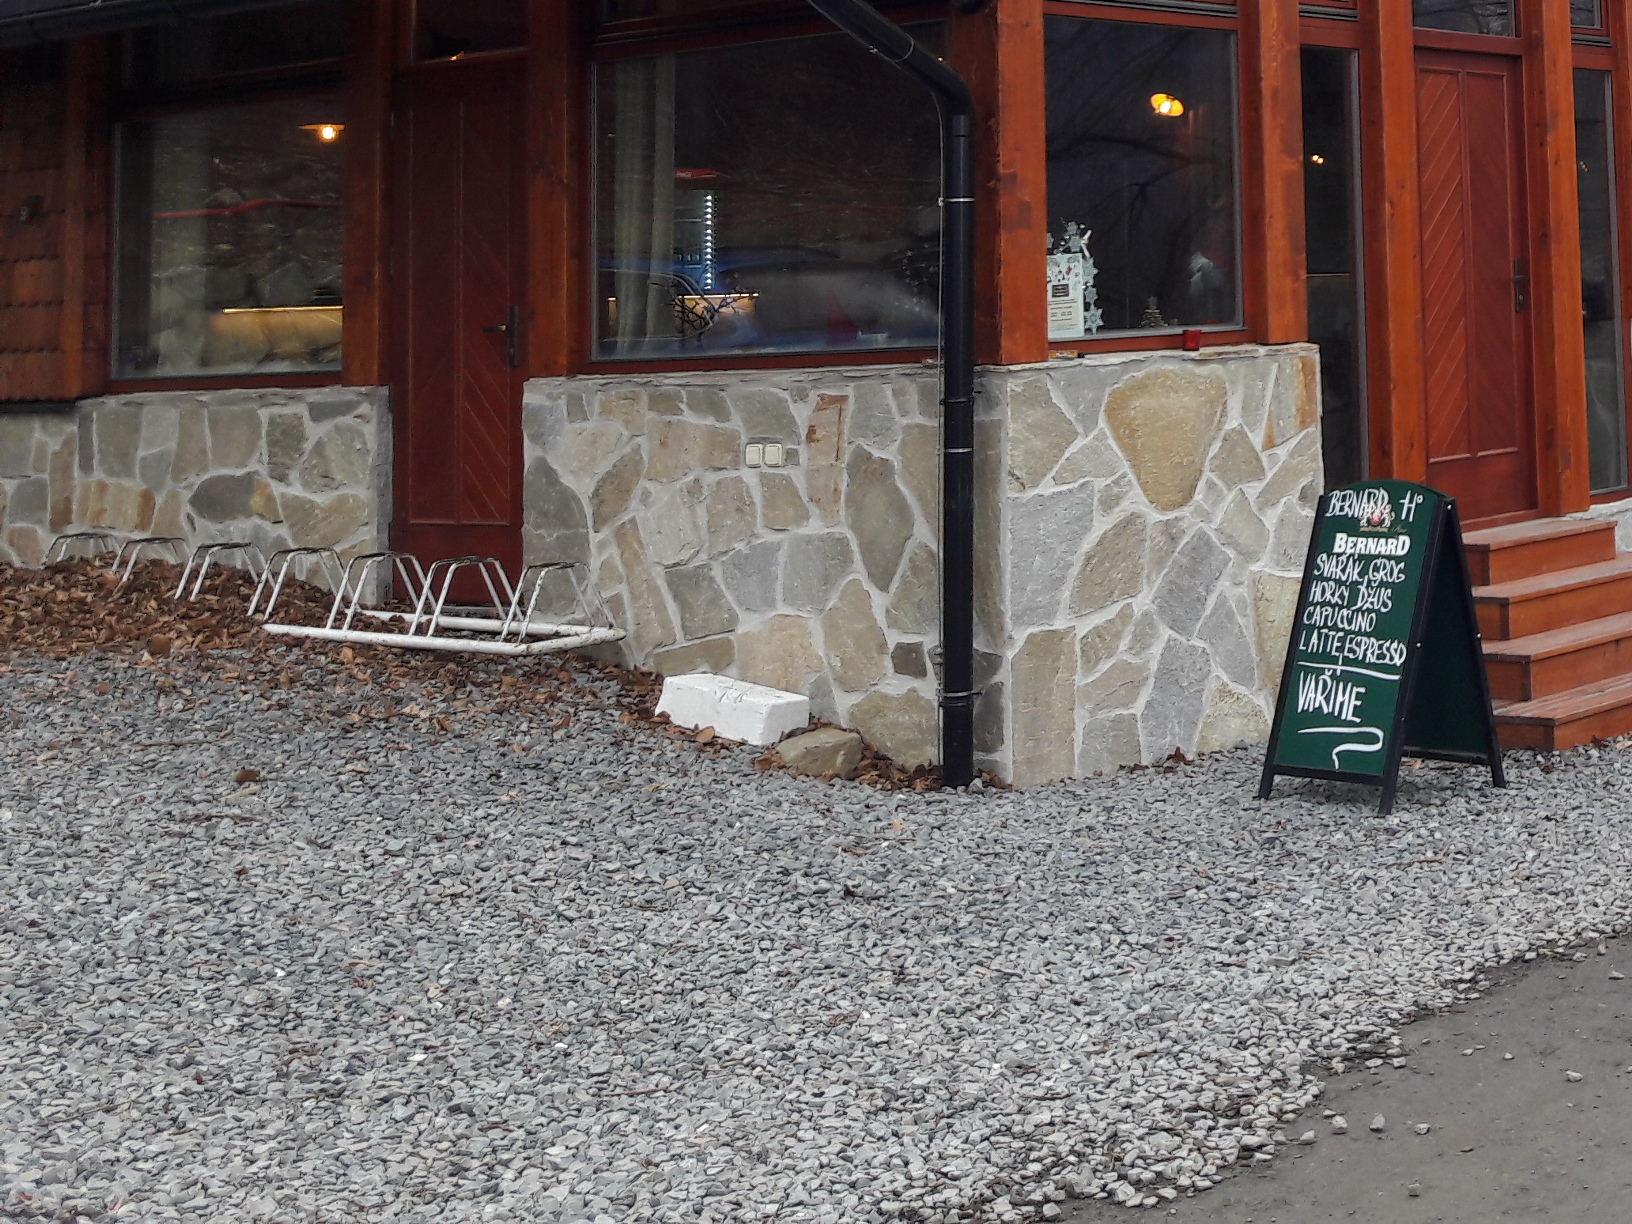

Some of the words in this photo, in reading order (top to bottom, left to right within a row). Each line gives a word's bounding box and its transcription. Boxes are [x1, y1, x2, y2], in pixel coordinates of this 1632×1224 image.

[1325, 487, 1390, 519] BERNARD
[1332, 532, 1411, 556] BERNARD
[1303, 605, 1377, 632] CAPUCCINO
